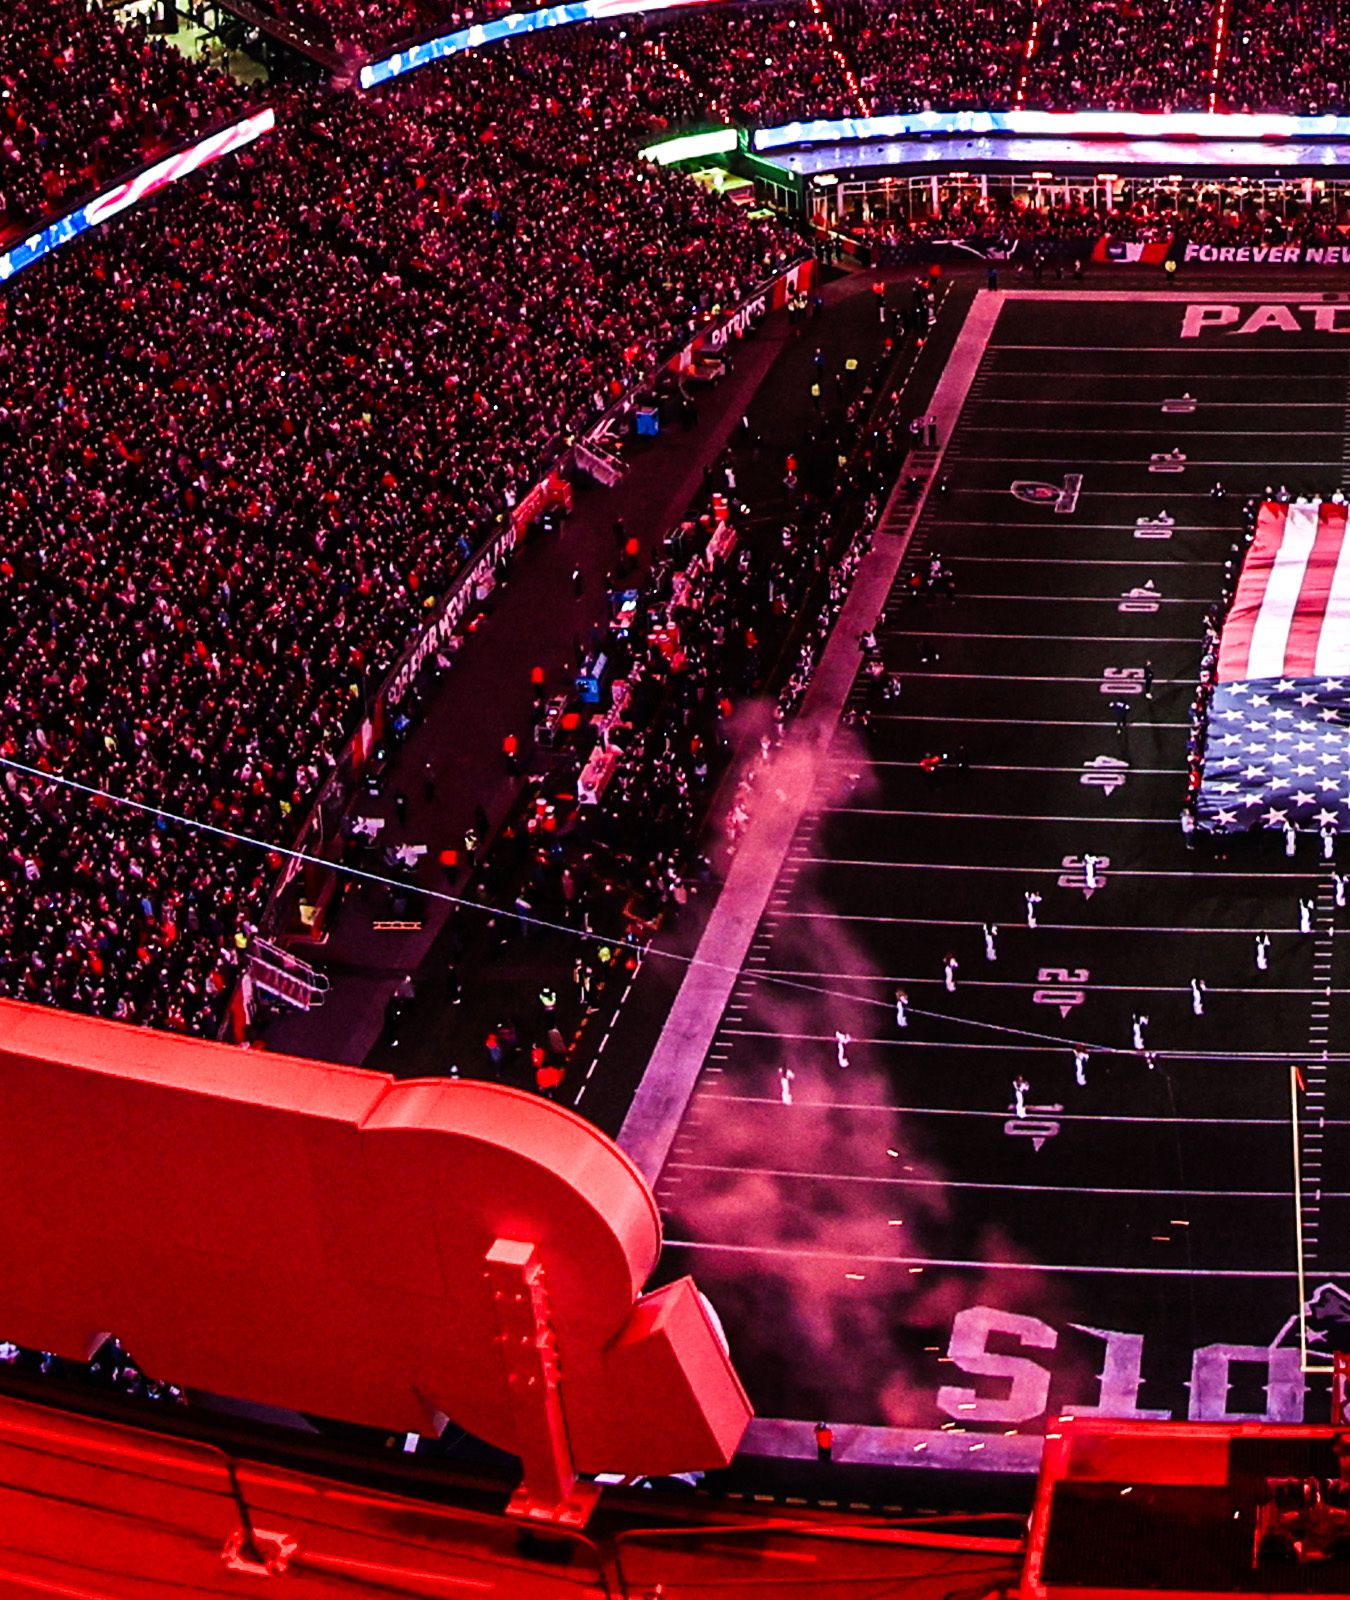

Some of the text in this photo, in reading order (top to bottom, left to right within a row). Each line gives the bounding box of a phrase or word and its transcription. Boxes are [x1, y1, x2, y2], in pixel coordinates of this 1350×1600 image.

[1184, 244, 1300, 262] FOREVER
[1100, 667, 1145, 693] 50
[1033, 968, 1089, 1004] 20
